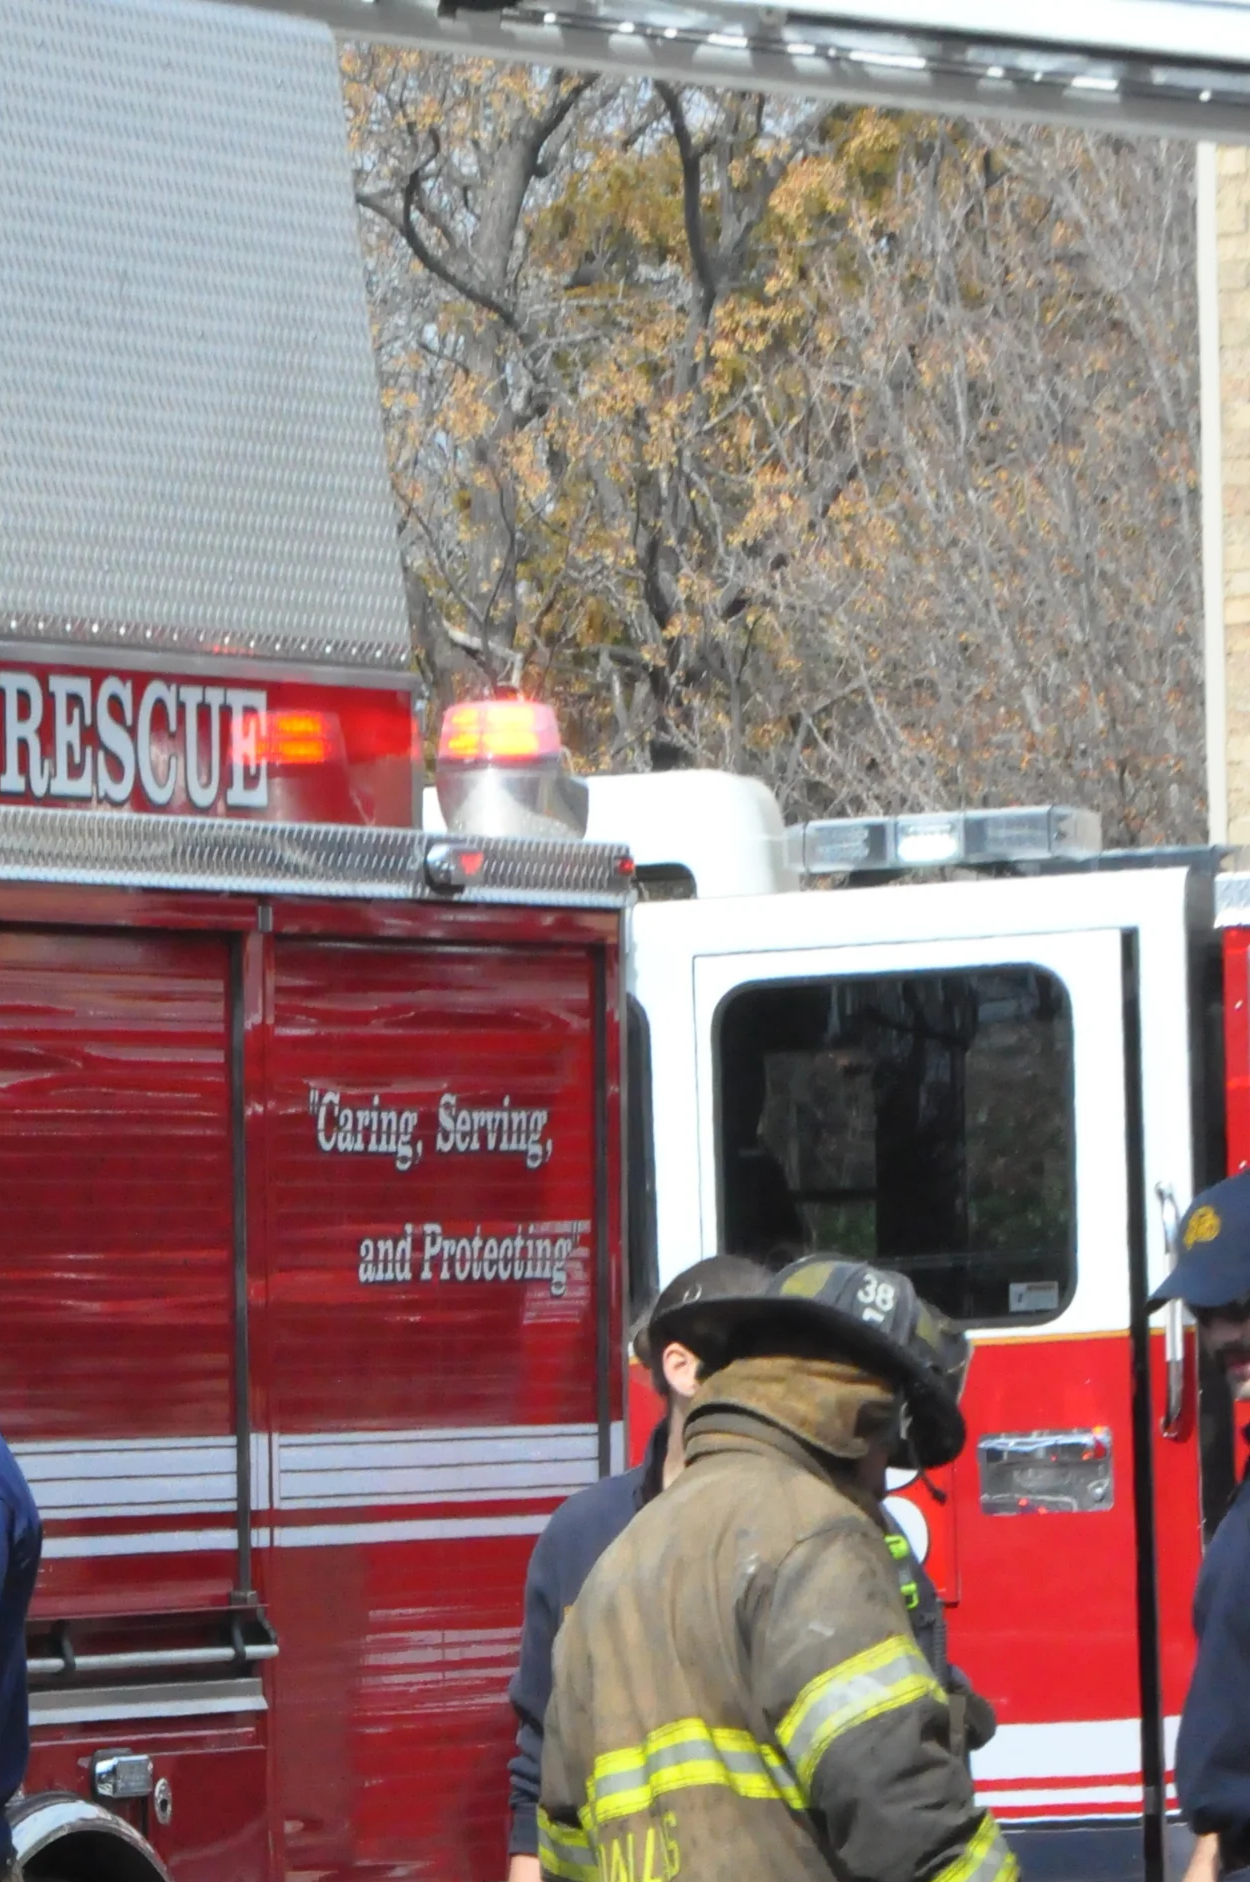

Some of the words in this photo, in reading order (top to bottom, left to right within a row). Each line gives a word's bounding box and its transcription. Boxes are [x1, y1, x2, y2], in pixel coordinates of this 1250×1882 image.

[436, 1093, 553, 1169] Serving,
[358, 1223, 414, 1284] and
[857, 1273, 895, 1312] 38
